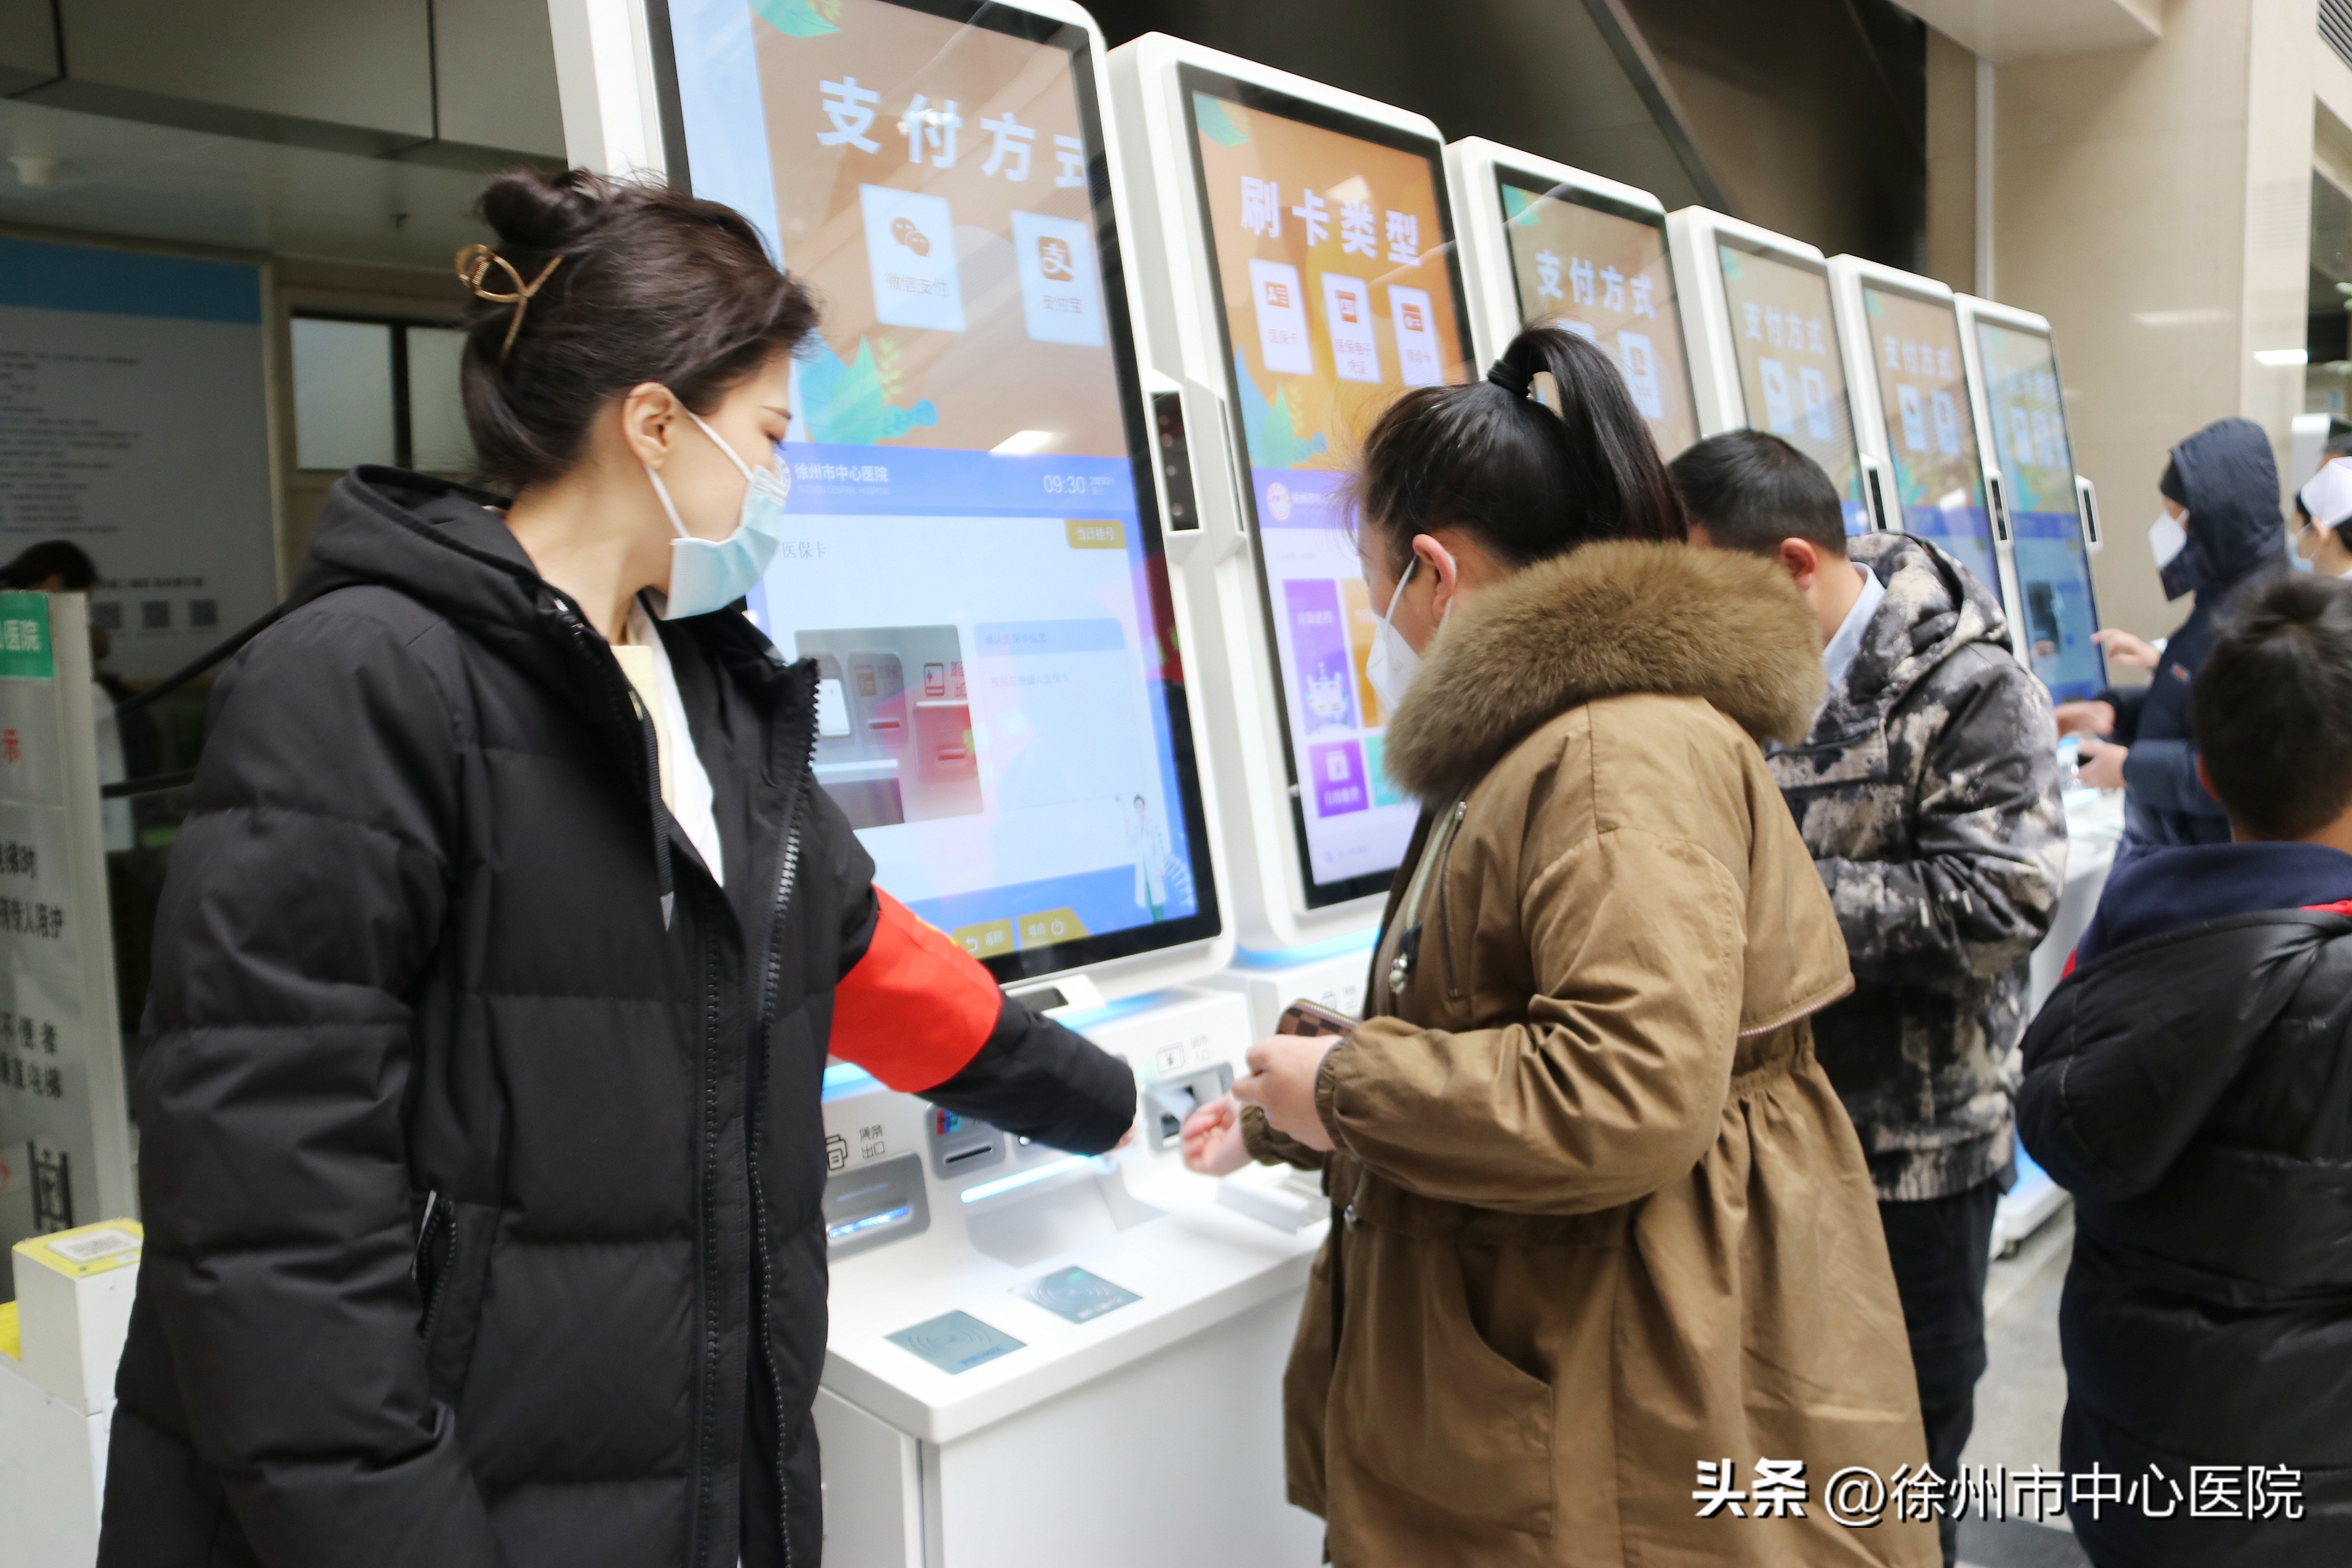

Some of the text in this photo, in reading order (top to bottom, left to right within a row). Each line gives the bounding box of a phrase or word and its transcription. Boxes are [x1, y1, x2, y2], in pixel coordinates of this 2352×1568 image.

[1240, 175, 1422, 267] 刷卡类型
[885, 273, 948, 296] 微信支付
[1536, 248, 1657, 319] 支付方式
[1042, 295, 1083, 313] 支付宝
[1743, 300, 1825, 356] 支付方式
[1883, 334, 1954, 381] 支付方式
[794, 463, 889, 482] 徐州市中心医院
[1043, 475, 1086, 494] 09:30
[782, 541, 826, 558] 医保卡
[0, 619, 40, 651] 医院
[861, 1141, 885, 1159] 出口
